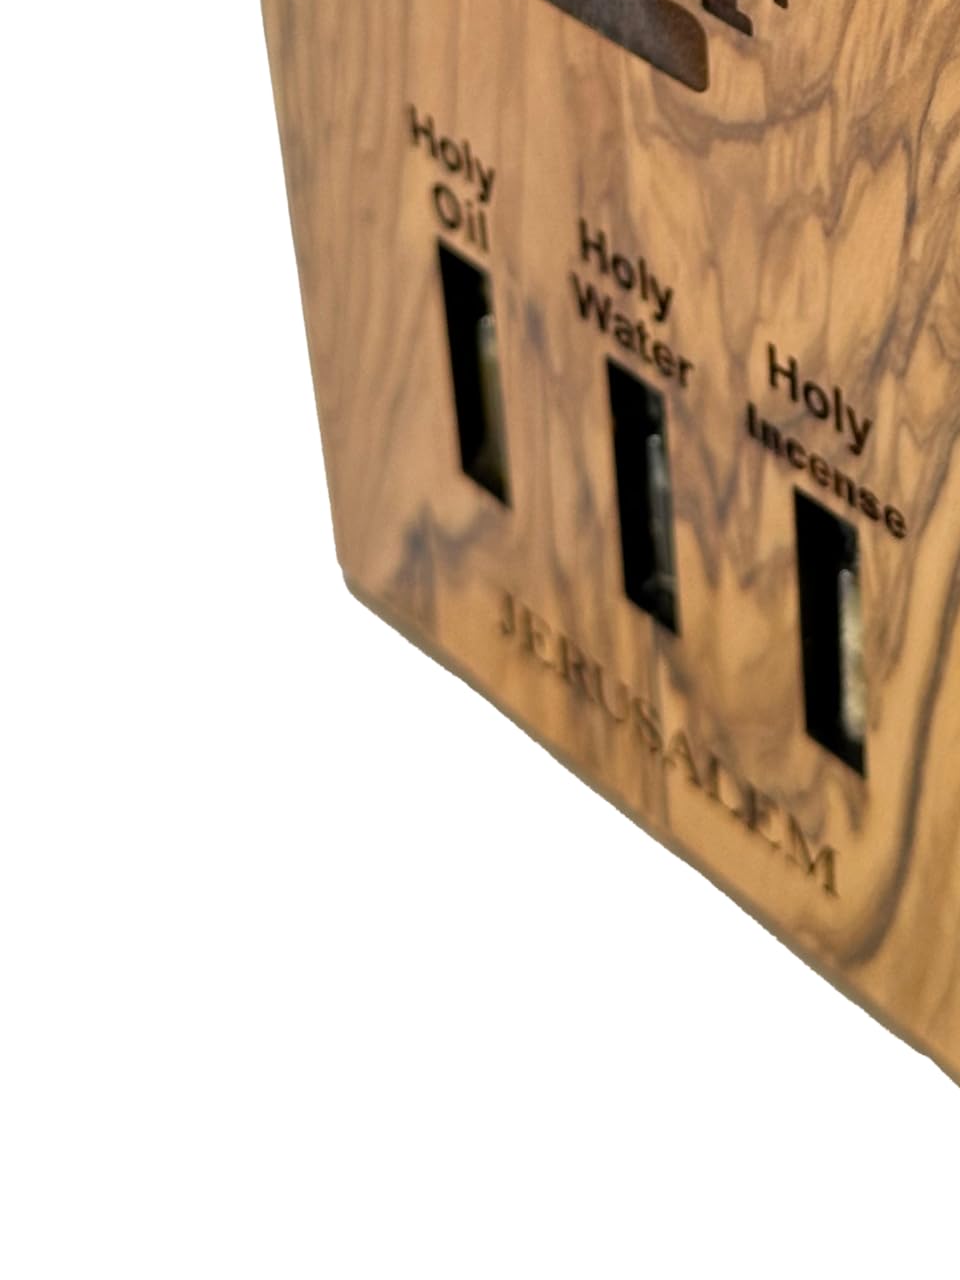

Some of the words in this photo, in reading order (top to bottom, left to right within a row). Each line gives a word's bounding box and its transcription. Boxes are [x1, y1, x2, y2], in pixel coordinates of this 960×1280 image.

[408, 105, 495, 202] Holy
[431, 182, 489, 252] Oil
[578, 217, 674, 321] Holy
[570, 270, 695, 388] Water
[767, 342, 873, 455] Holy
[746, 401, 908, 540] Incense
[500, 592, 840, 899] JERUSALEM
